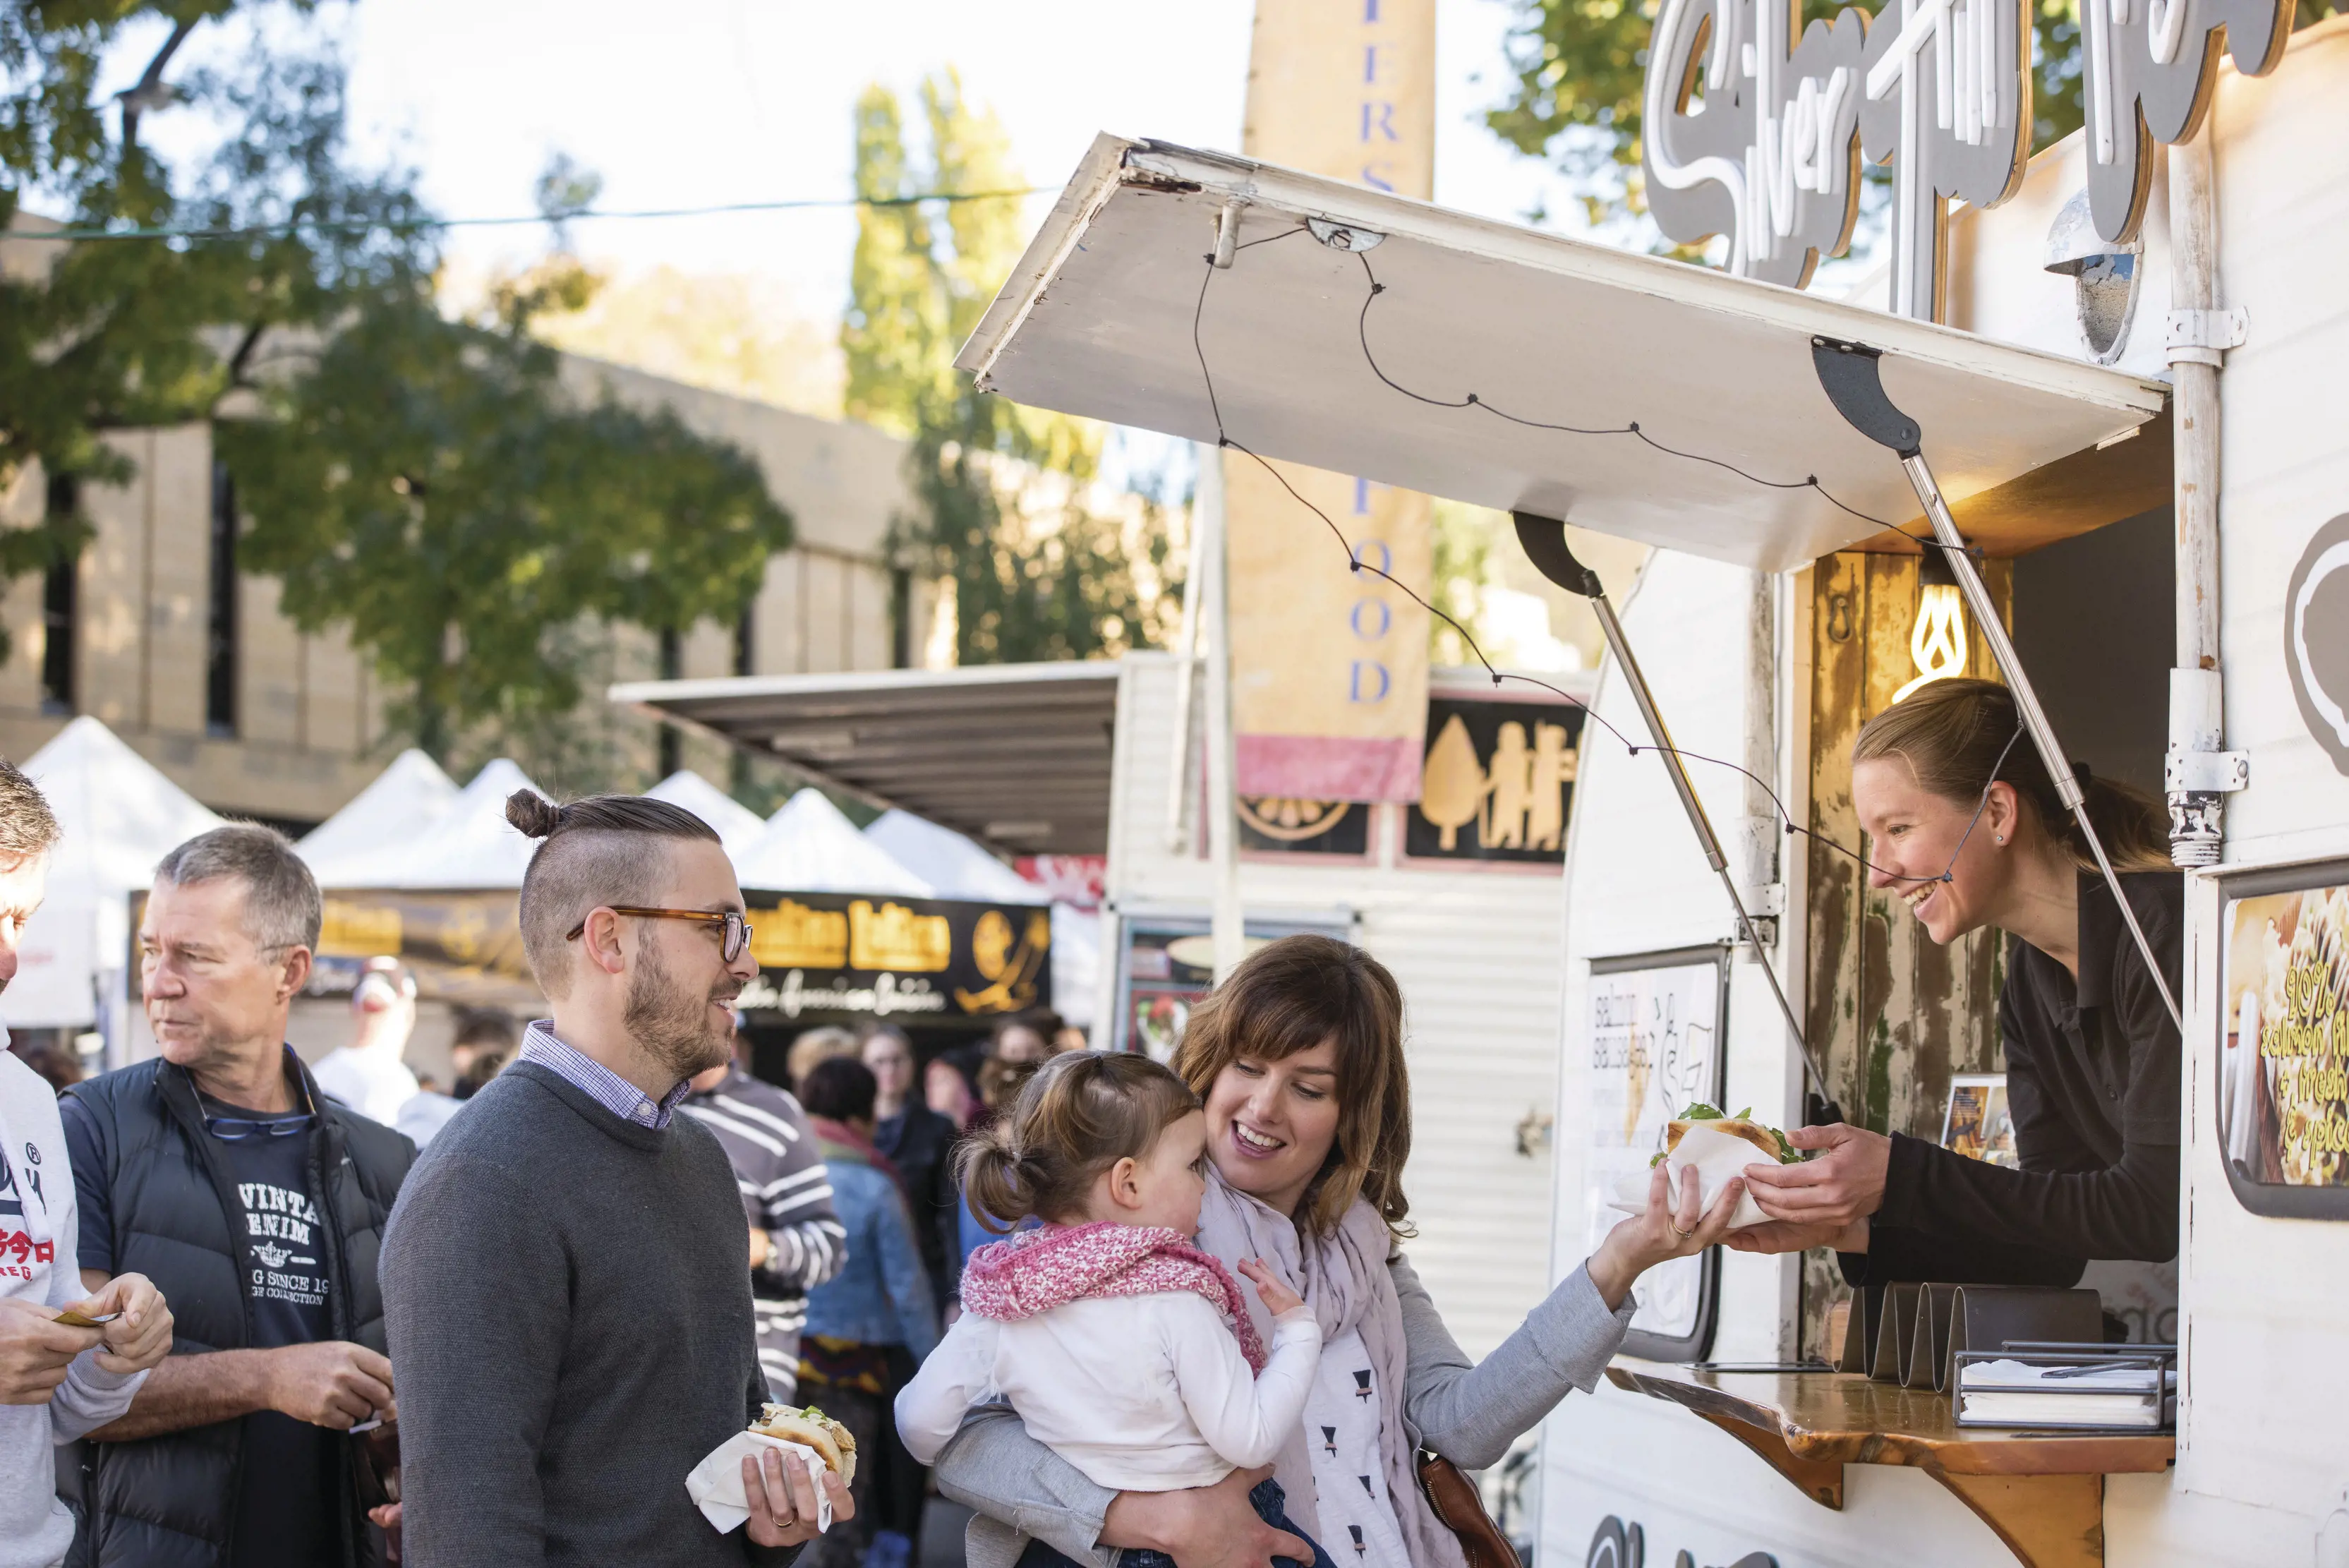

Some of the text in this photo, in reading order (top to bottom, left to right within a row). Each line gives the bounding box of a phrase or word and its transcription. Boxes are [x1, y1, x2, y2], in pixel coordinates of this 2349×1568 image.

[2261, 1017, 2324, 1060] salmon
[2297, 1056, 2348, 1104] fresh
[267, 1271, 309, 1292] SINCE
